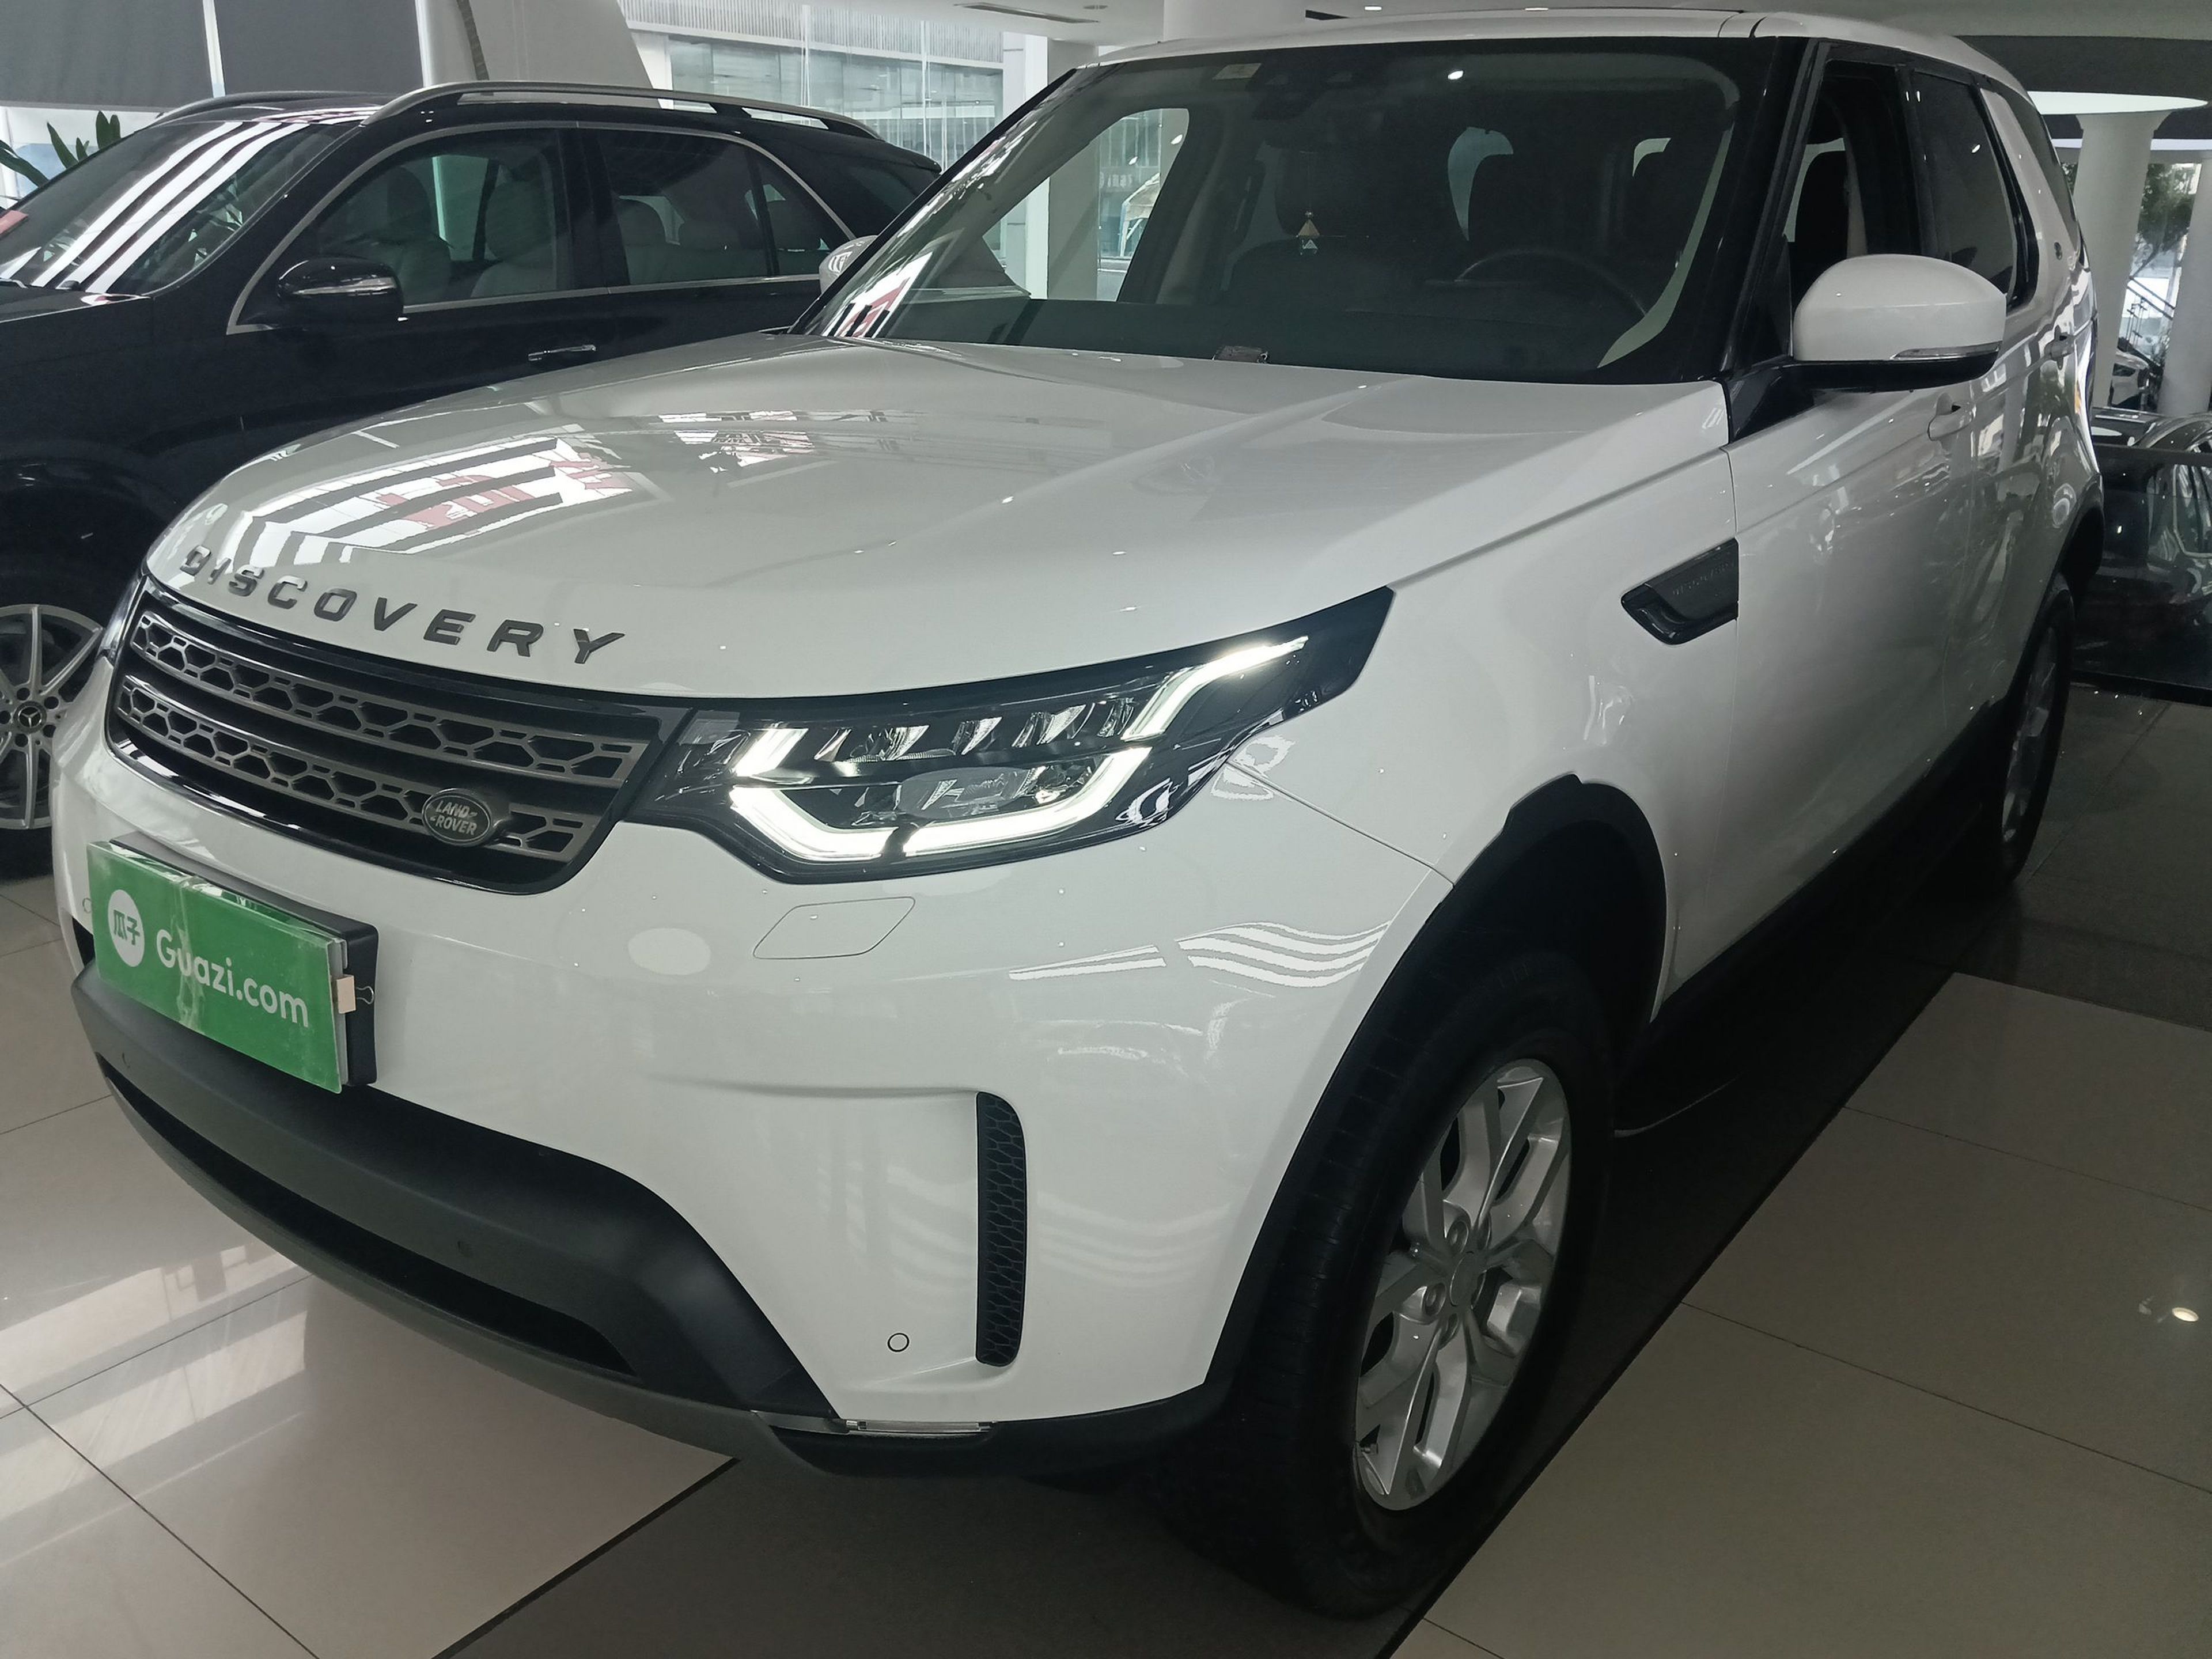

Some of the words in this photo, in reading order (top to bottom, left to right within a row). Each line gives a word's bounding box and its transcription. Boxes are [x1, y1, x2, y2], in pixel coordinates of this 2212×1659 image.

[180, 544, 625, 664] DISCOVERY
[435, 800, 471, 819] LAND
[435, 815, 478, 835] ROVER
[113, 909, 141, 946] 瓜子
[156, 929, 309, 1028] Guazi.com
